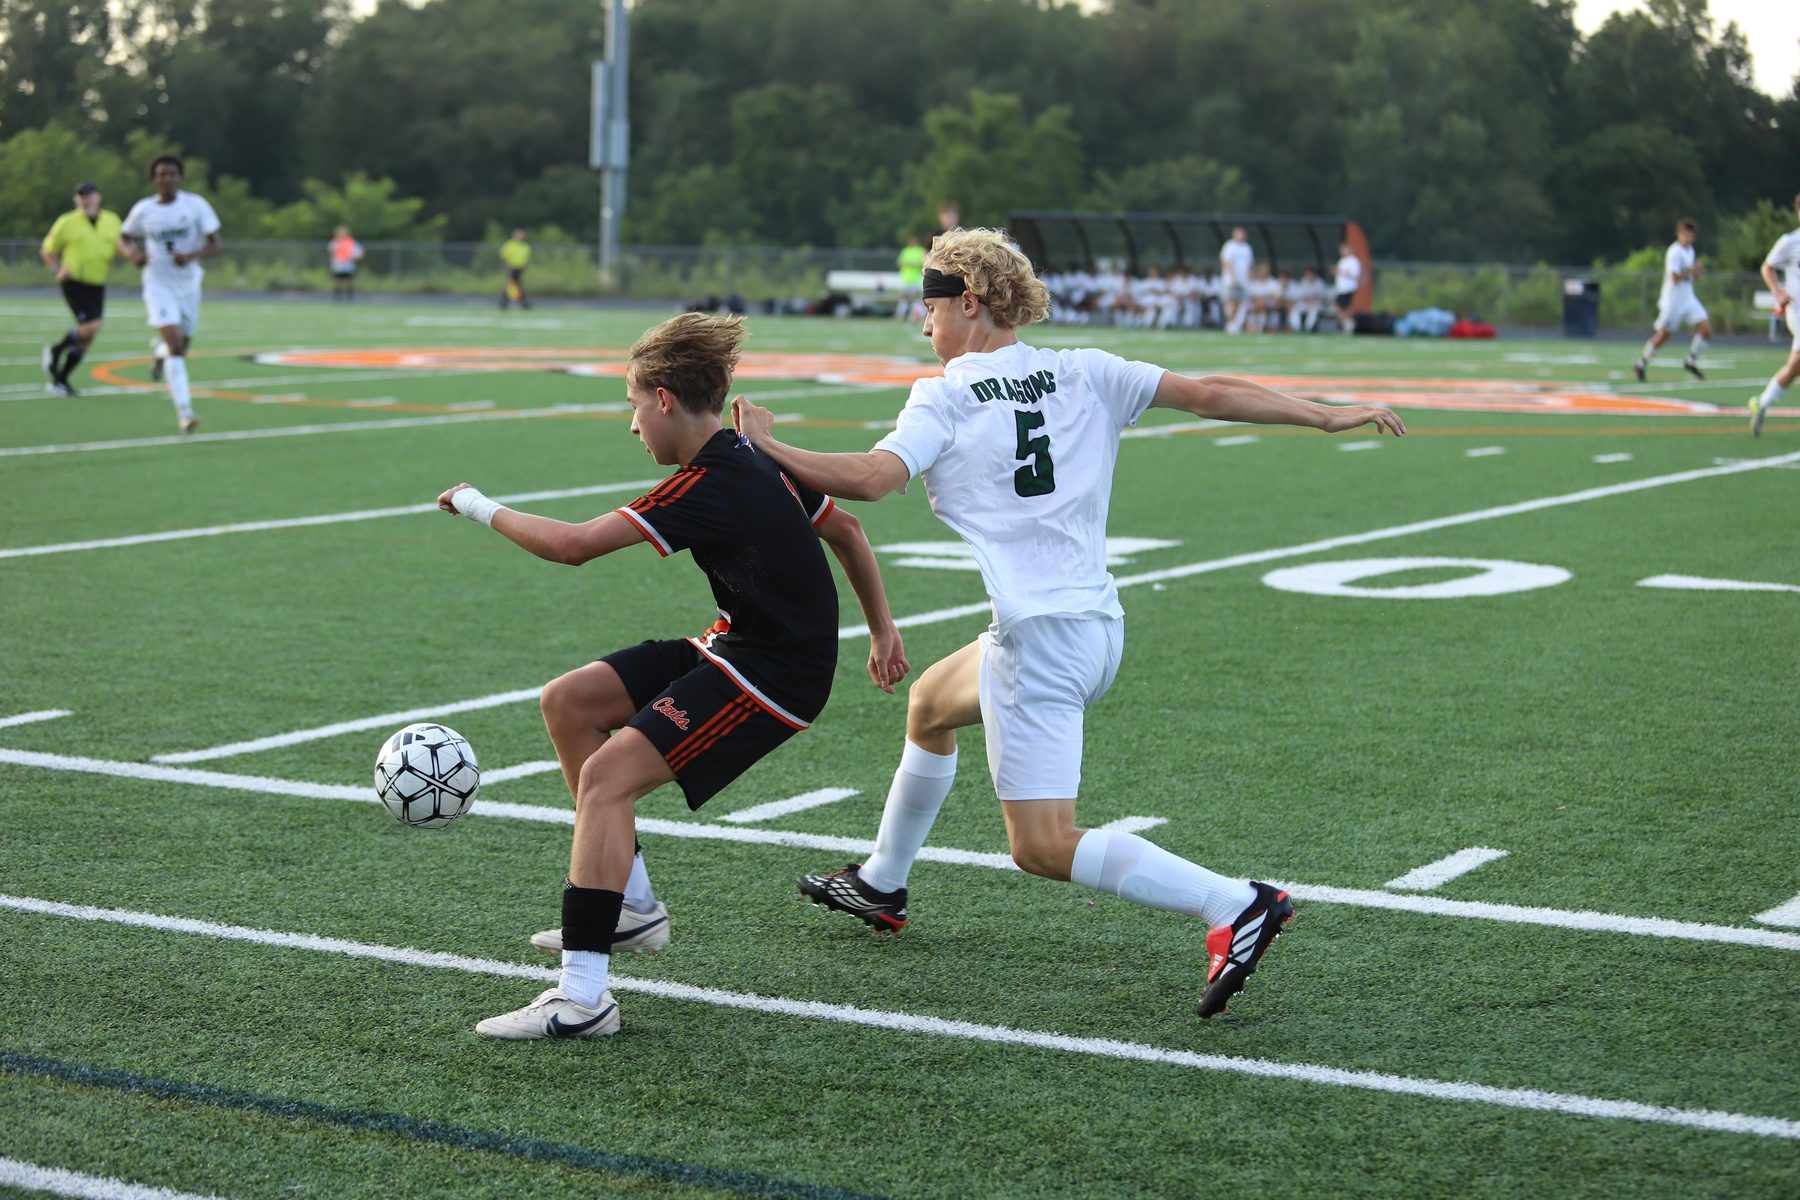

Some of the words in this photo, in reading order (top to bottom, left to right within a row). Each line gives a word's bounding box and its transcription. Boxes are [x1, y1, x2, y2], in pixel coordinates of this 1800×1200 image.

[969, 369, 1057, 404] DRAGONS
[1013, 409, 1056, 498] 5
[652, 696, 690, 731] Cats
